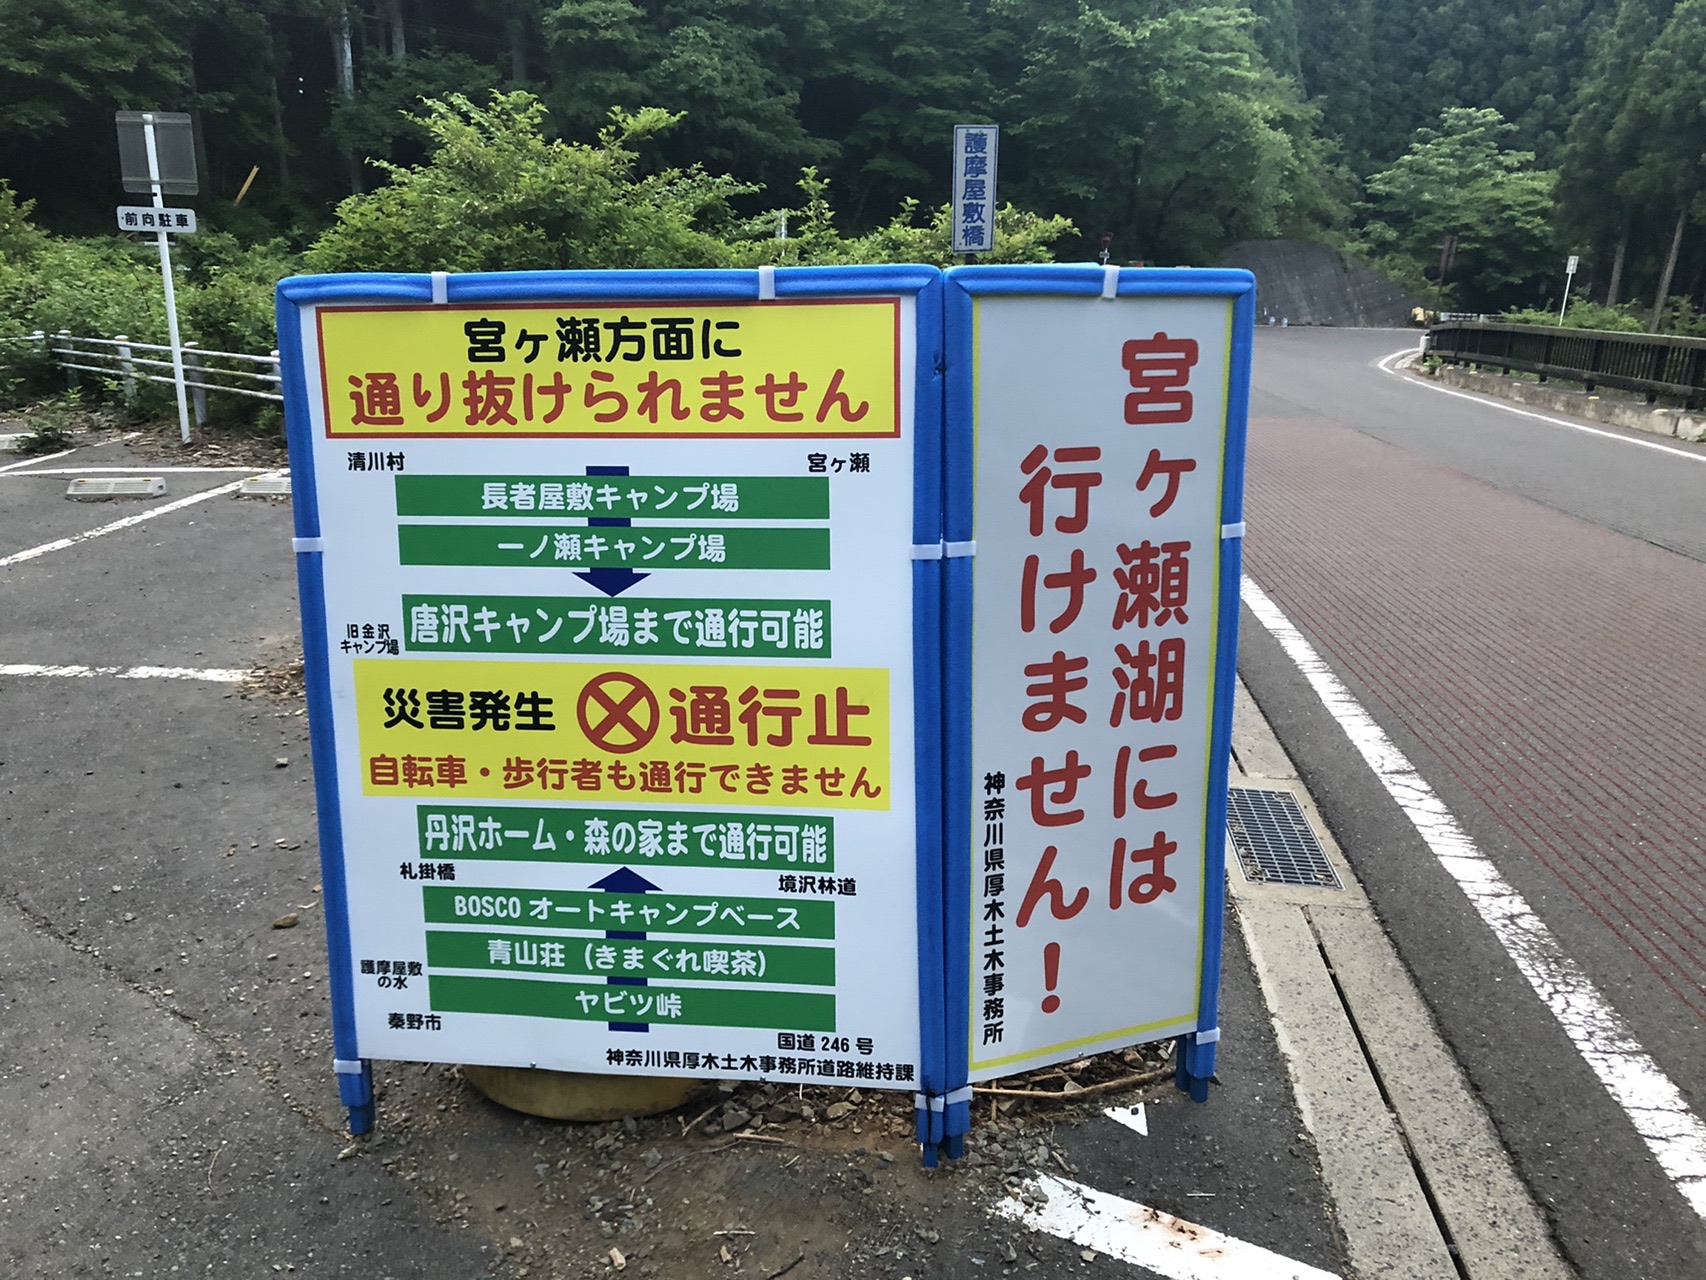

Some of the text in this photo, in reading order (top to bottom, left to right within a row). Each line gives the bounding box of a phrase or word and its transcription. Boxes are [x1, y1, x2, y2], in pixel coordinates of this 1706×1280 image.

[962, 132, 988, 247] 護摩屋敷橋
[124, 212, 189, 228] 前向駐車
[464, 316, 742, 364] 宮ヶ瀬方面に
[349, 368, 870, 427] 通り抜けられません
[347, 451, 405, 472] 清川村
[807, 452, 871, 474] 宮ヶ瀬
[481, 482, 740, 514] 長者屋敷キャンプ場
[497, 532, 726, 563] 一ノ瀬キャンプ場
[346, 623, 391, 640] 旧金沢
[410, 603, 825, 652] 唐沢キャンプ場まで通行可能
[340, 638, 400, 655] キャンプ場
[382, 687, 556, 731] 災害発生
[669, 685, 873, 746] 通行止
[369, 754, 883, 799] 自転車・歩行者も通行できません
[424, 815, 828, 864] 丹沢ホーム・森の家まで通行可能
[400, 862, 456, 882] 札掛橋
[778, 874, 857, 897] 境沢林道
[454, 895, 801, 931] BOSCO オートキャンプベース
[982, 771, 1006, 1046] 神奈川県厚木土木事務所
[361, 959, 423, 979] 護摩屋敷
[487, 939, 766, 979] 青山荘 (きまぐれ喫茶)
[377, 975, 408, 991] の水
[575, 990, 683, 1019] ヤビツ峠
[388, 1013, 442, 1032] 秦野市
[778, 1032, 874, 1056] 国道 246 号
[606, 1047, 915, 1083] 神奈川県厚木土木事務所道路維持課
